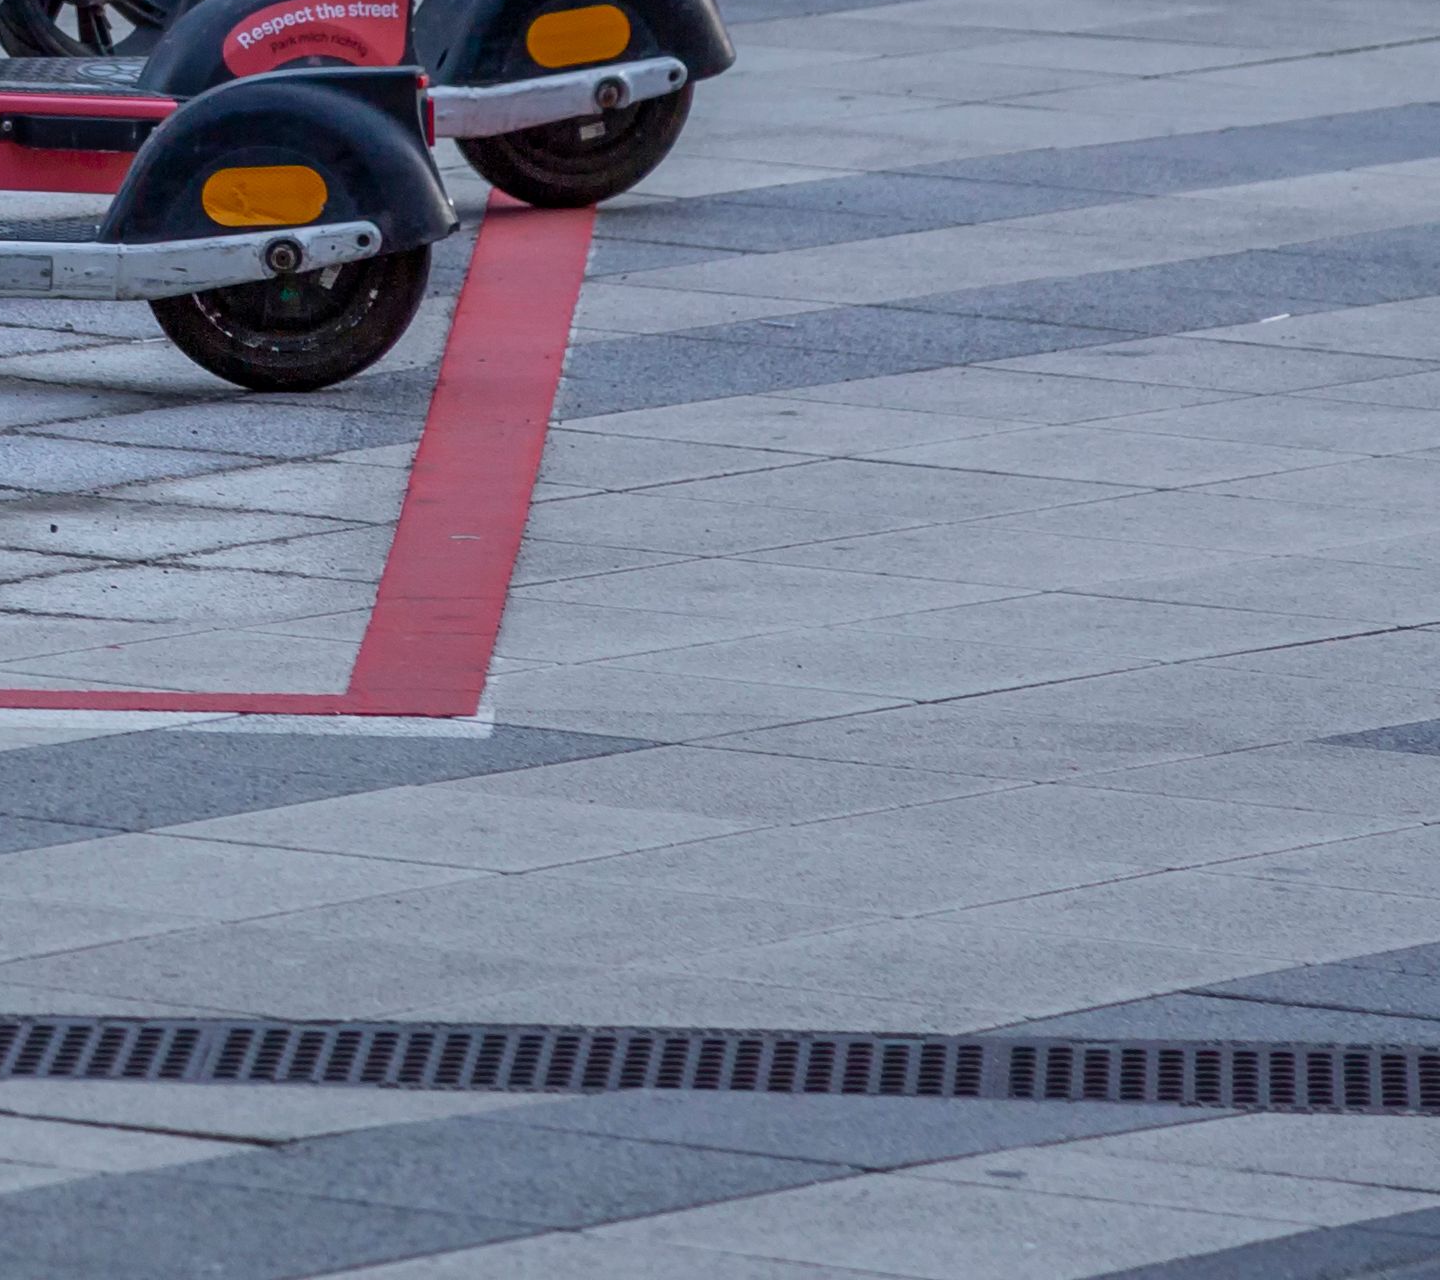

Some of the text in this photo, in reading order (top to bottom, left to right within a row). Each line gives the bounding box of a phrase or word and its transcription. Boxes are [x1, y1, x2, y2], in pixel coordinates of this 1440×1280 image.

[236, 0, 400, 50] Respect the street
[269, 32, 369, 58] Park mich richtig
